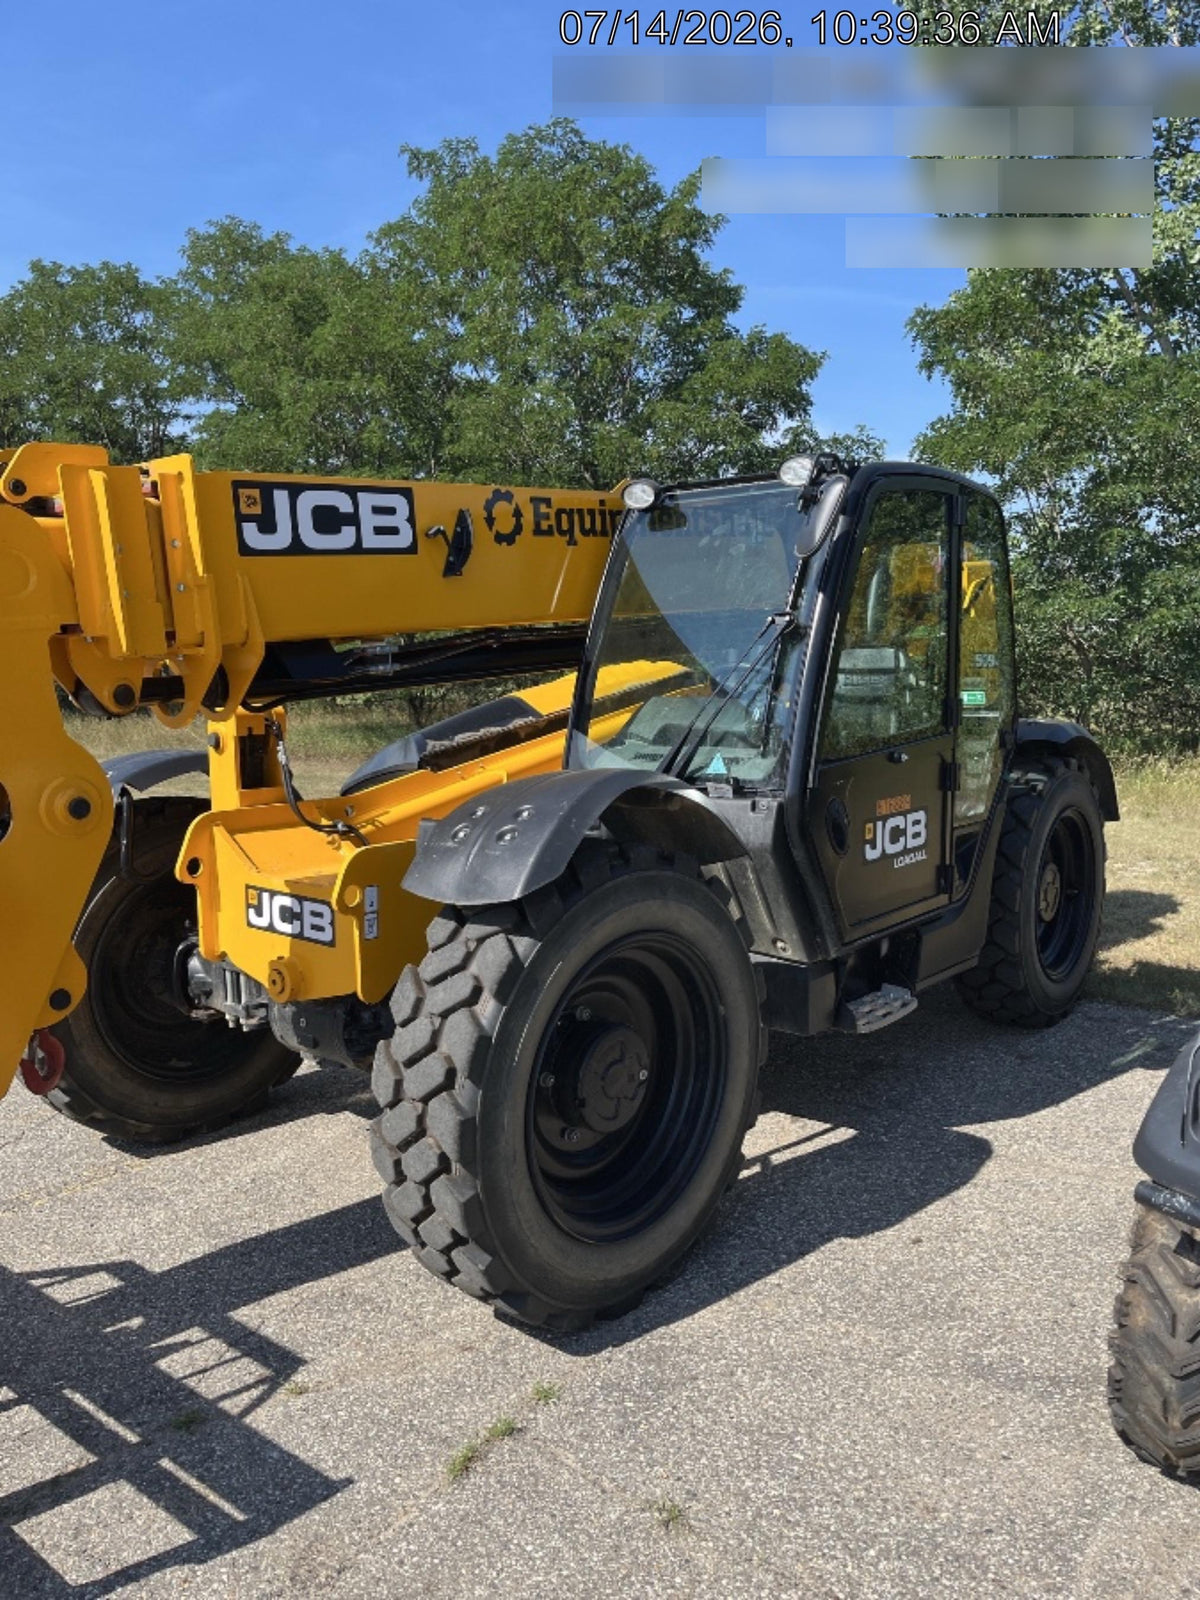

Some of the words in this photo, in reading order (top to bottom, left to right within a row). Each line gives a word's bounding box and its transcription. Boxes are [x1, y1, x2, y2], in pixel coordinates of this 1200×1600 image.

[241, 488, 413, 550] JCB
[865, 809, 928, 861] JCB
[248, 892, 333, 942] JCB
